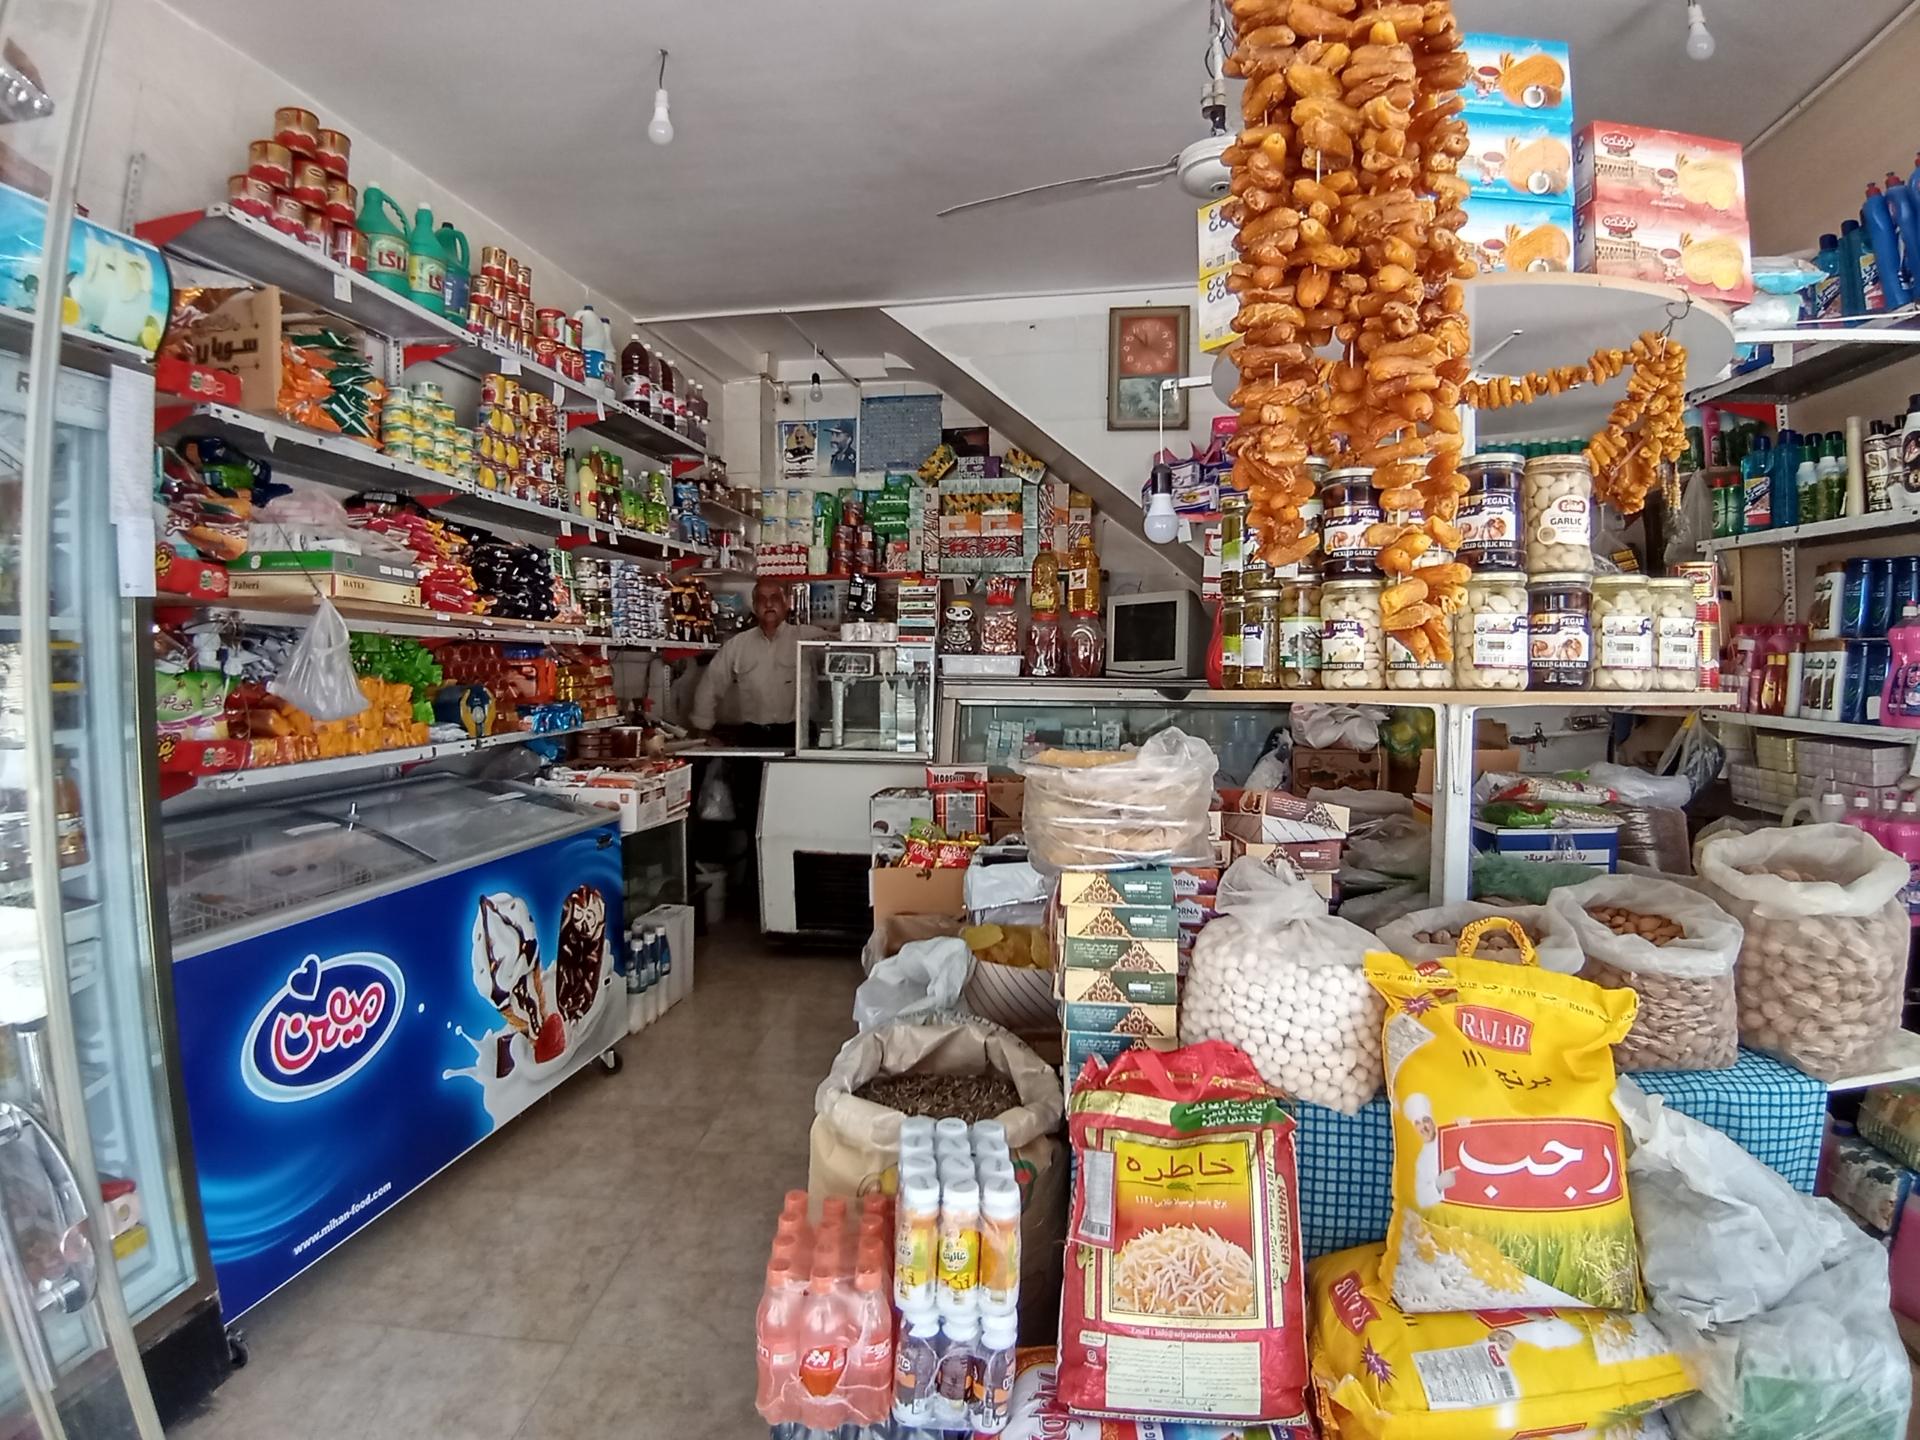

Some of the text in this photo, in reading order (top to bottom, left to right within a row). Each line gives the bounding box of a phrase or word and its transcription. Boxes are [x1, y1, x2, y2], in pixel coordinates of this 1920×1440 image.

[1482, 497, 1509, 505] PEGAH
[1550, 518, 1582, 526] GARLIC
[232, 580, 260, 590] Jaberi
[1561, 618, 1585, 626] PEGAH
[271, 982, 385, 1075] میهن
[1460, 1011, 1528, 1049] RAJAB
[1494, 1068, 1552, 1090] برنج
[1126, 1152, 1235, 1182] خاطره
[1458, 1138, 1614, 1200] رجب
[293, 1181, 392, 1256] www.mihan-food.com
[1277, 1184, 1290, 1266] KHATEREH
[1335, 1278, 1371, 1330] RAJAB
